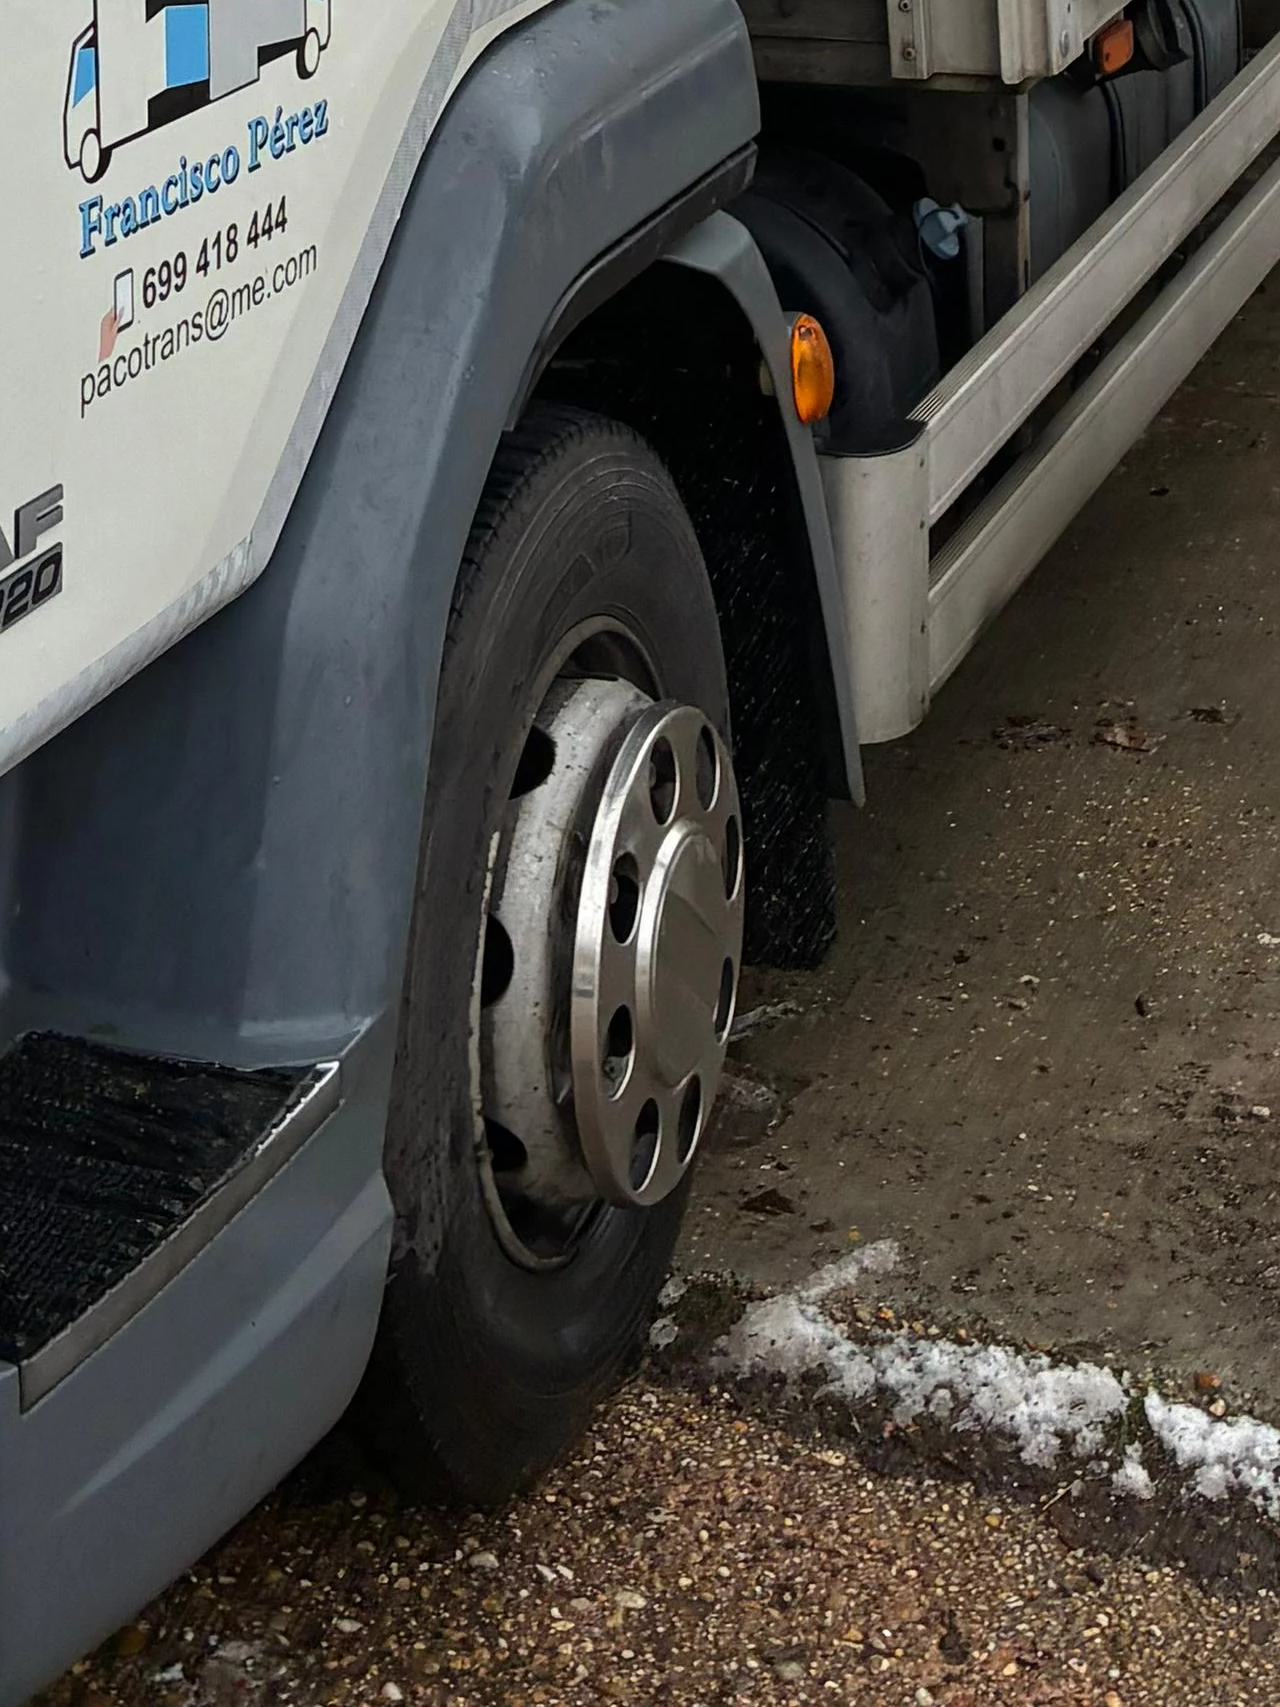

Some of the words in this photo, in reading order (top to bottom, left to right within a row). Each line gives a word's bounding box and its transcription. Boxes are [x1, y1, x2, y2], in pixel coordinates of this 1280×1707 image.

[78, 145, 241, 259] Francisco
[247, 98, 330, 173] Pérez
[142, 251, 188, 309] 699
[195, 222, 239, 278] 418
[246, 195, 288, 250] 444
[80, 244, 318, 419] pacotrans@me.com
